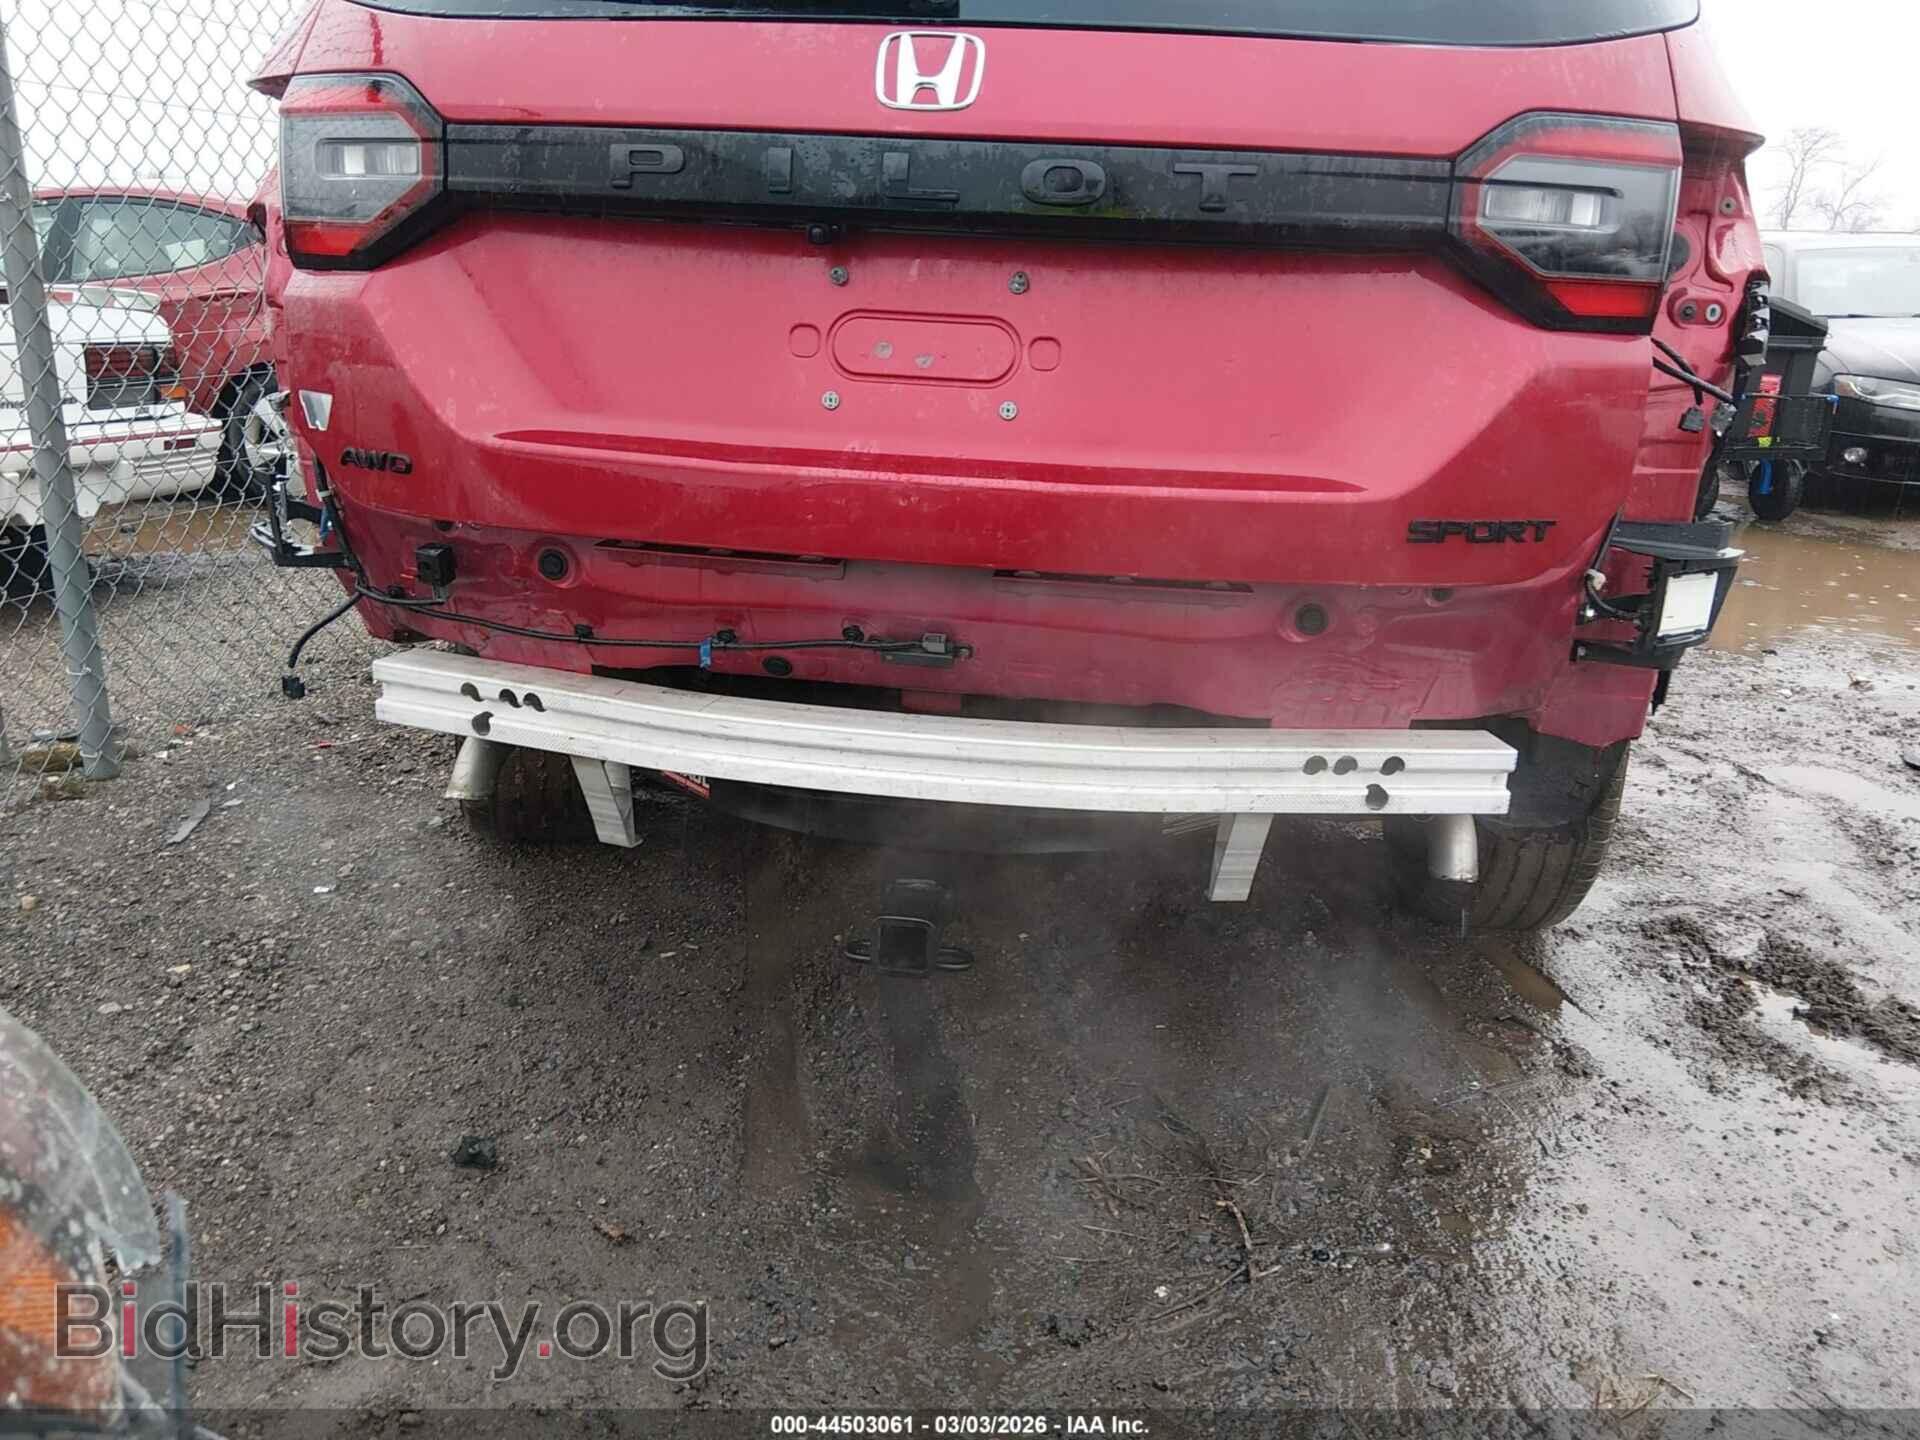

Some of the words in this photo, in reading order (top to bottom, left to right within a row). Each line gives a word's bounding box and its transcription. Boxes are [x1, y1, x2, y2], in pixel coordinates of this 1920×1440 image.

[609, 143, 1259, 212] PILOT
[340, 447, 413, 475] AWD
[1406, 519, 1558, 544] SPORT
